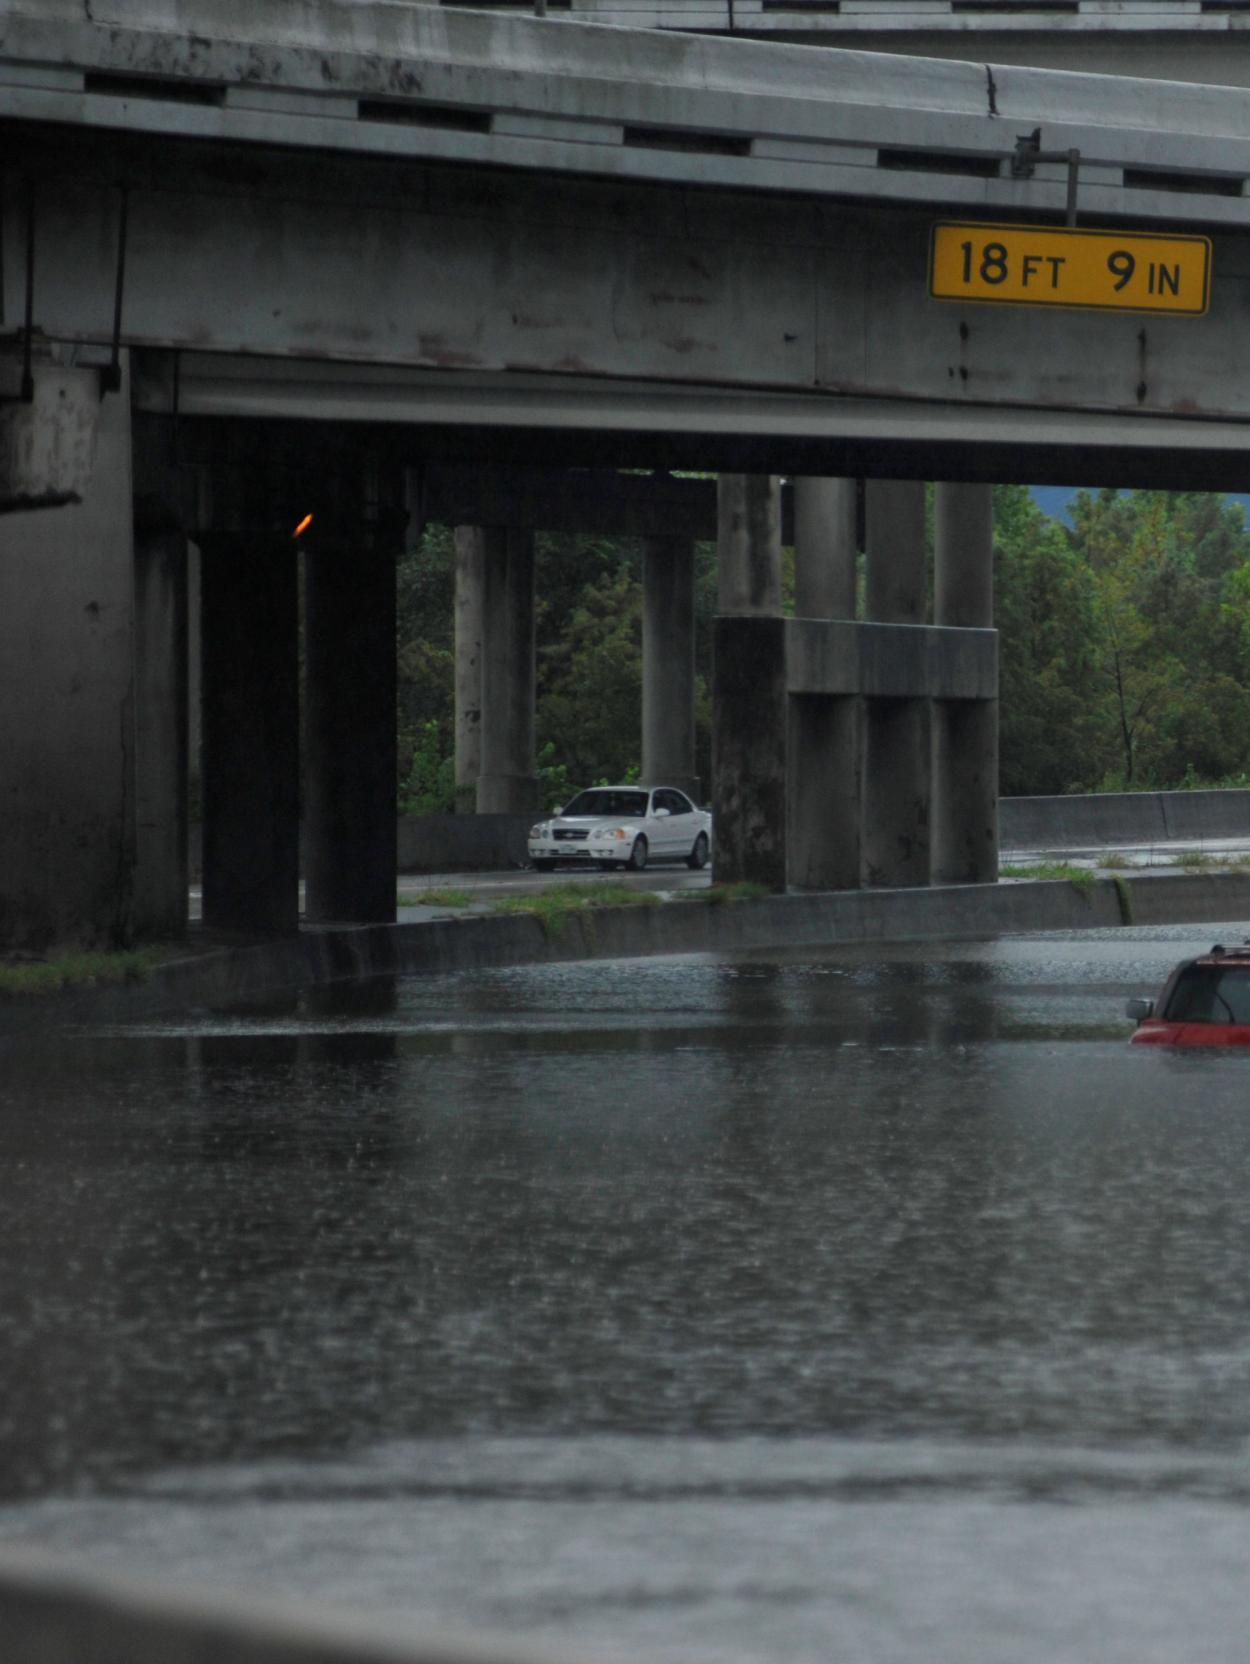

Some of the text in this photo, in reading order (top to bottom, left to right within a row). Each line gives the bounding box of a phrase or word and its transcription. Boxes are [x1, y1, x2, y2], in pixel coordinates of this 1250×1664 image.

[961, 241, 1180, 296] 18 FT 9 IN
